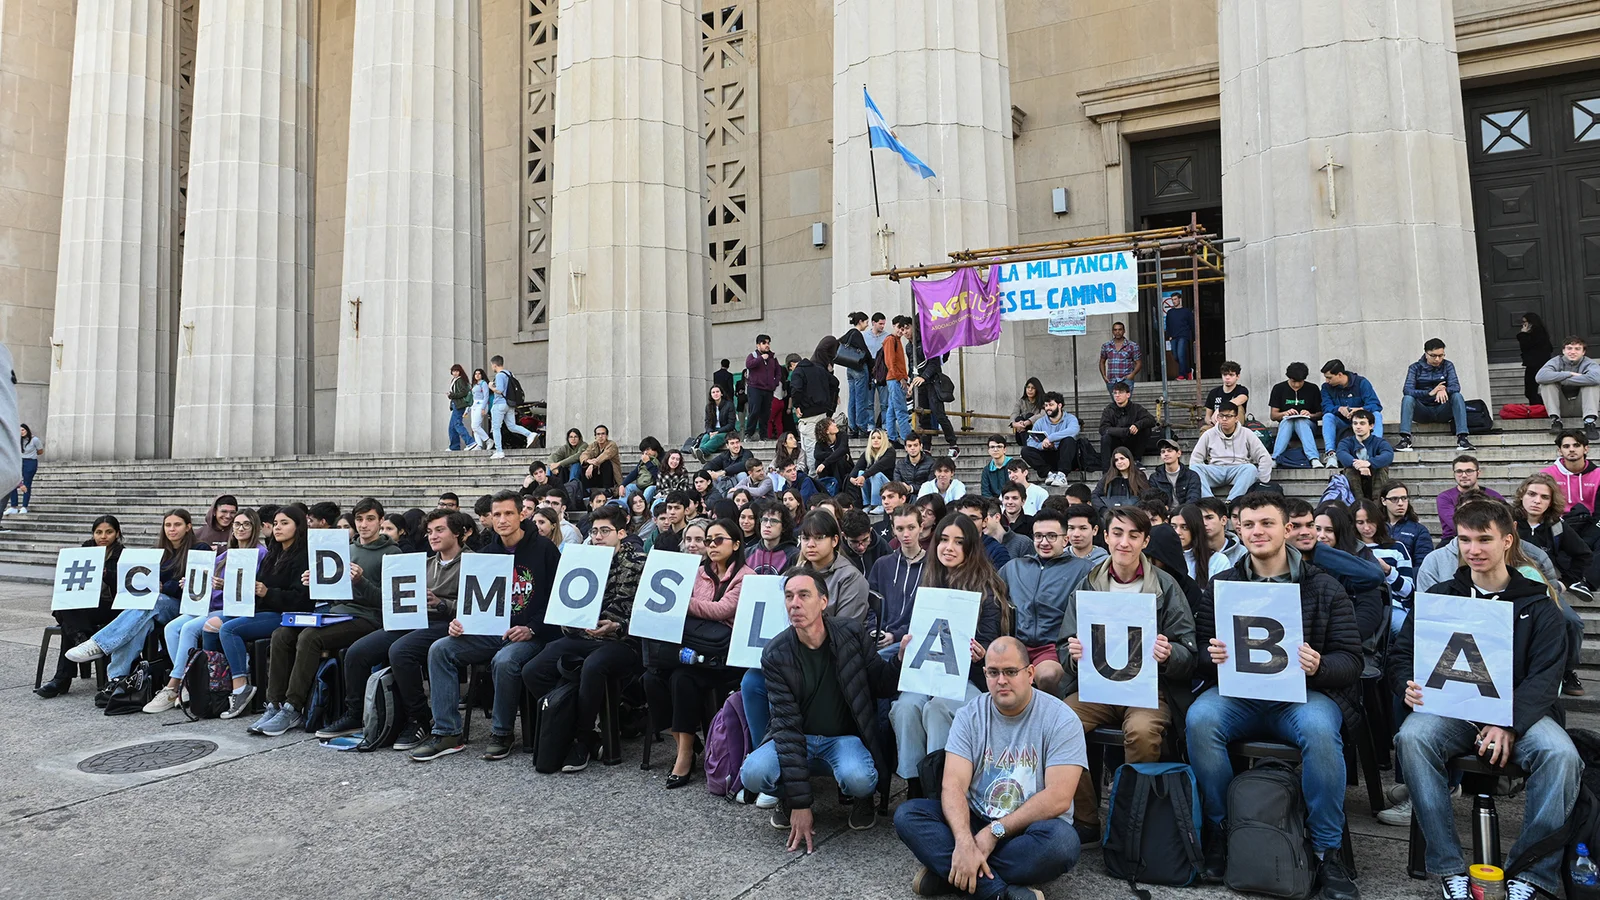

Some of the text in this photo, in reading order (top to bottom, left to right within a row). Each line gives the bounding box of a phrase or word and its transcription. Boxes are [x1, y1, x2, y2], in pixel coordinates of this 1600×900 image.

[998, 252, 1128, 282] LA MILITANCIA
[1020, 289, 1042, 310] EL
[1047, 282, 1117, 309] CAMINO
[124, 566, 151, 596] C
[188, 568, 208, 601] U
[316, 550, 344, 584] D
[558, 567, 599, 609] O
[391, 575, 417, 613] E
[463, 575, 507, 617] M
[644, 569, 685, 613] S
[747, 601, 772, 648] L
[1233, 615, 1289, 674] B
[909, 618, 960, 676] A
[1091, 624, 1142, 681] U
[1425, 632, 1501, 699] A
